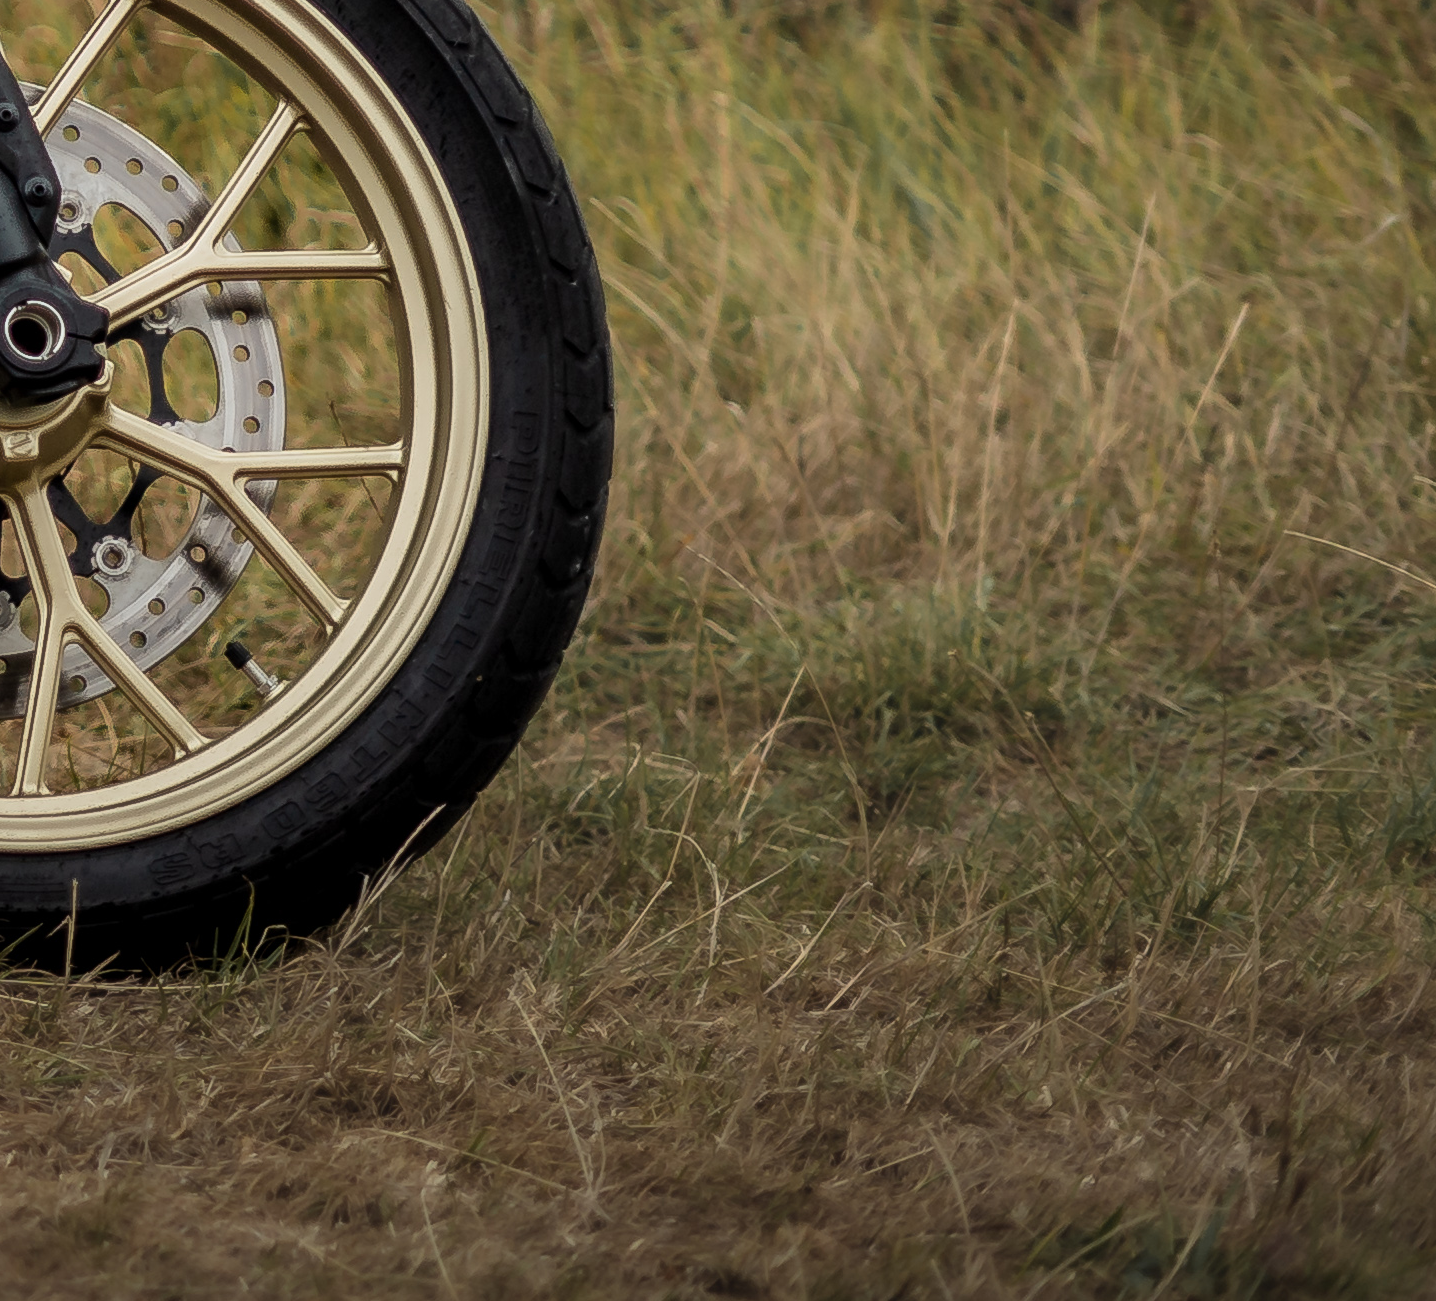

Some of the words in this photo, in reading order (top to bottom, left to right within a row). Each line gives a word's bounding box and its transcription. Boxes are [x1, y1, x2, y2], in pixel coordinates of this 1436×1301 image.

[422, 409, 549, 692] PIRELLI
[258, 695, 428, 845] MT60
[146, 831, 245, 891] RS
